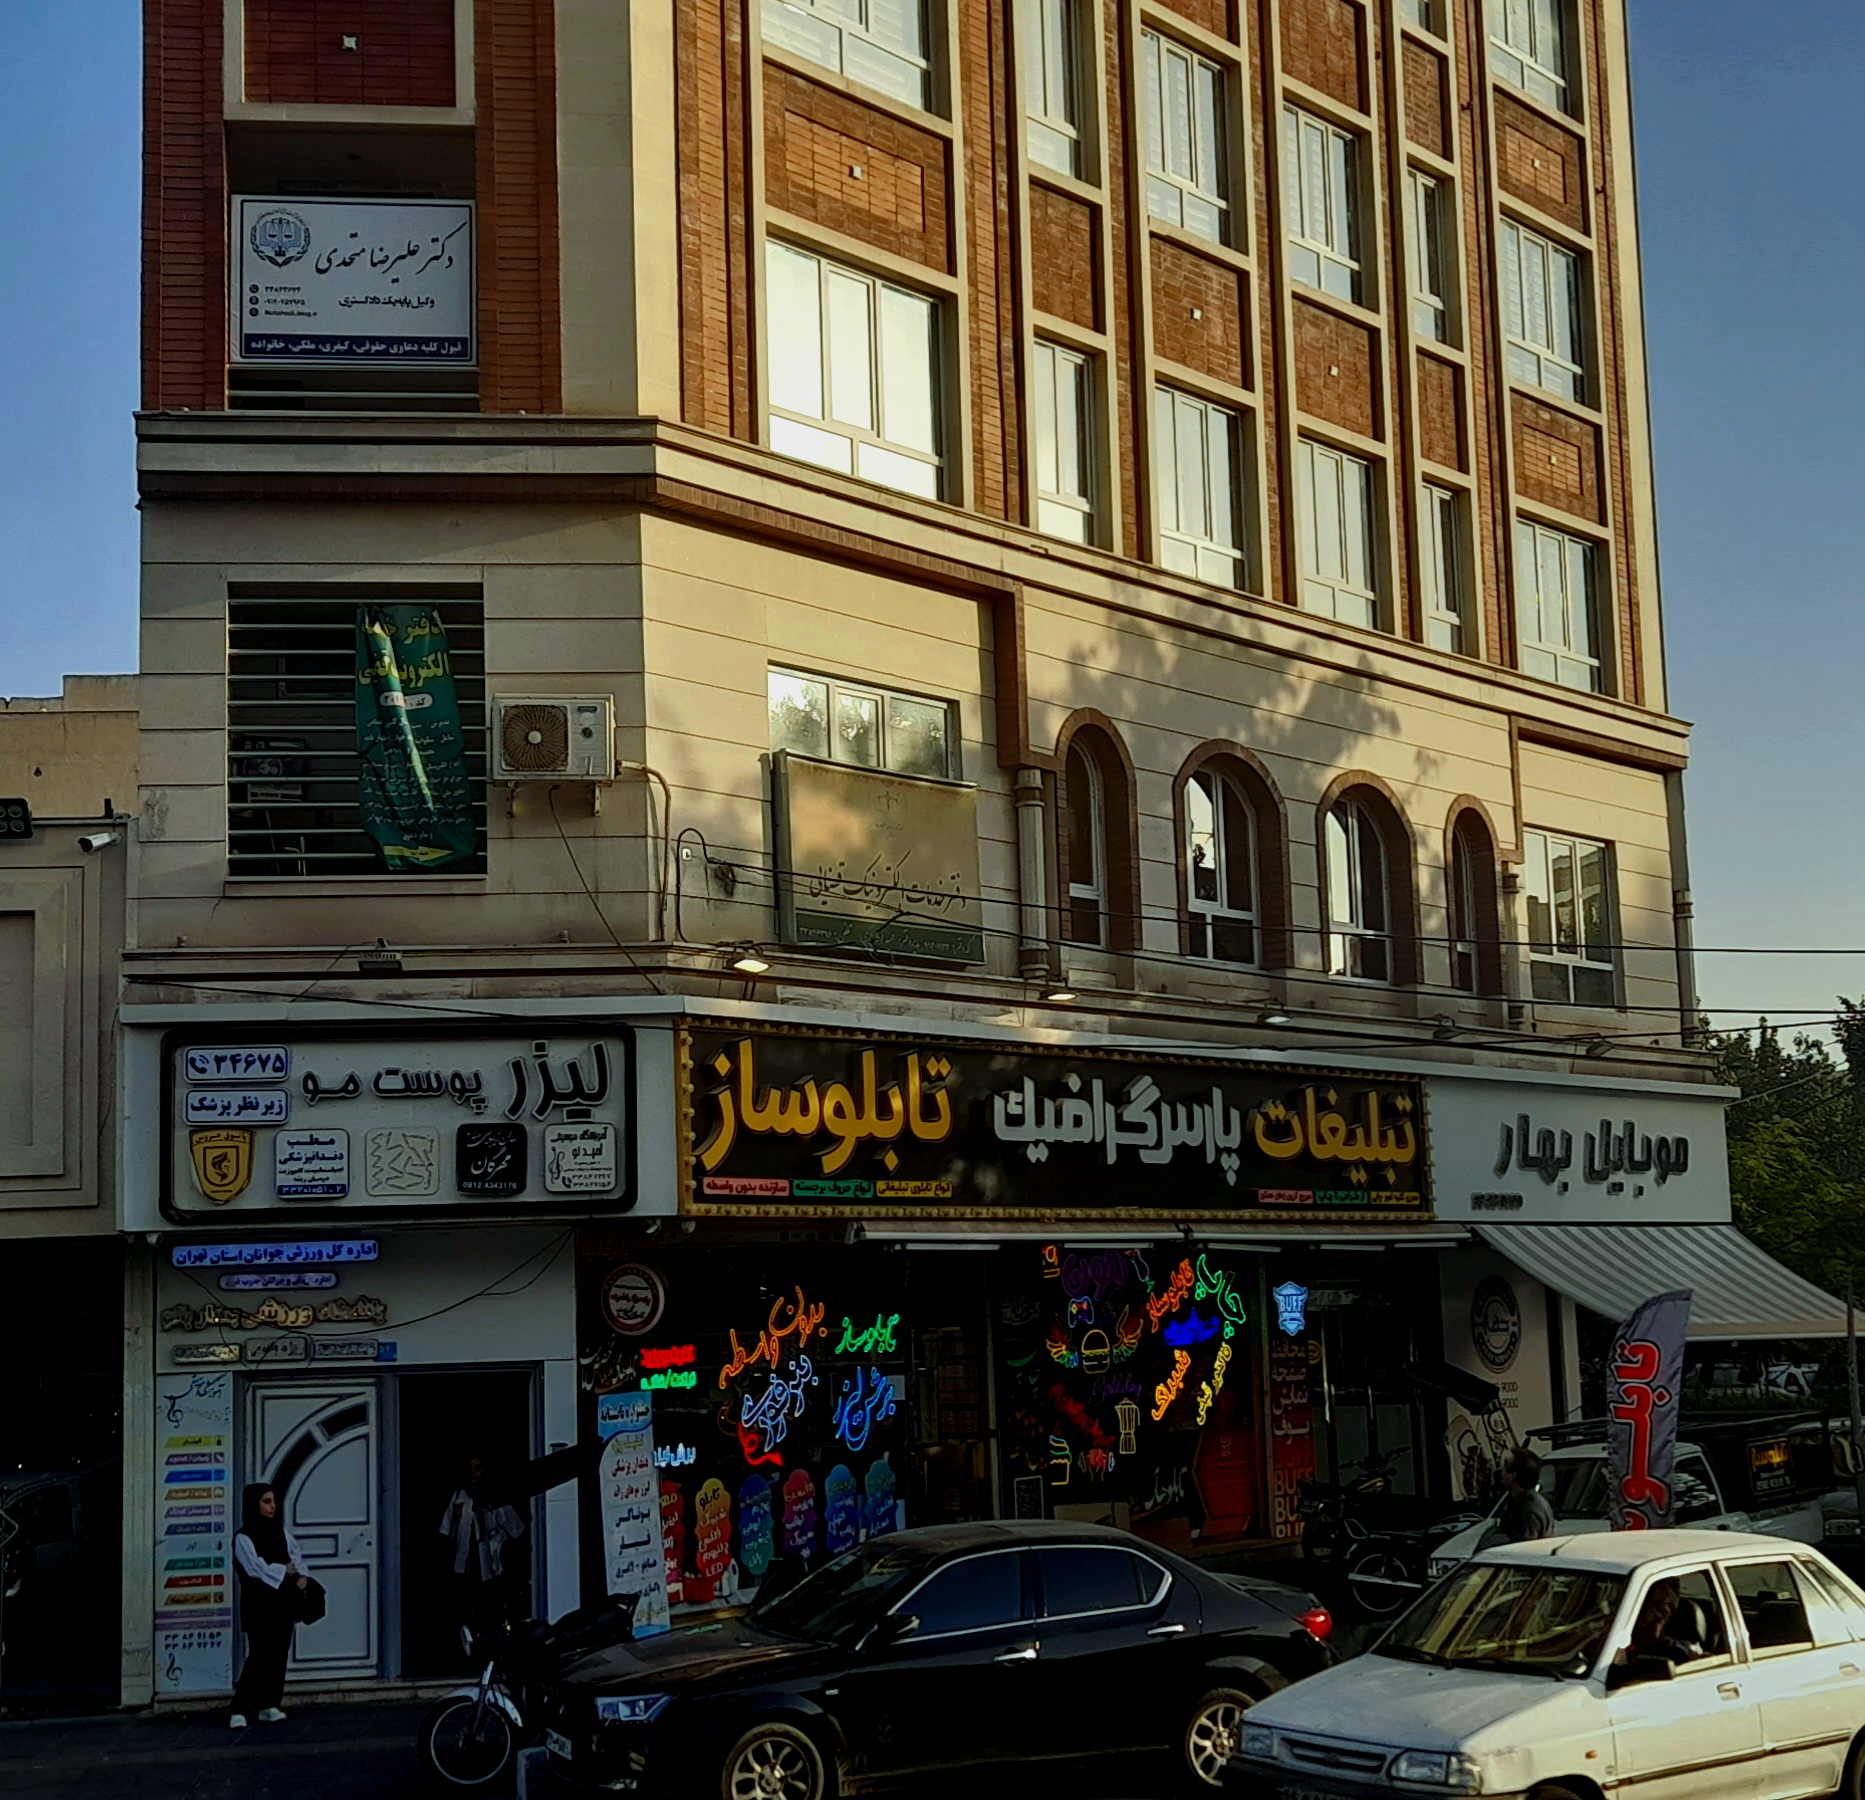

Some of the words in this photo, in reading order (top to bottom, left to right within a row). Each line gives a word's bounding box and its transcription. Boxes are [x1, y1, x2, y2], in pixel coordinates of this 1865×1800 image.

[314, 231, 367, 275] متحدی
[415, 220, 468, 275] دکتر
[369, 239, 420, 284] علیرضا
[412, 297, 435, 309] وکیل
[250, 338, 286, 352] خانواده
[388, 341, 419, 354] دعاوی
[421, 341, 439, 352] کلیه
[213, 1053, 285, 1075] ۳۴۶۷۵
[301, 1070, 363, 1107] مو
[372, 1067, 490, 1114] پوست
[504, 1040, 611, 1124] لیزر
[190, 1096, 232, 1117] پزشک
[234, 1095, 260, 1117] نظر
[261, 1098, 284, 1117] زیر
[692, 1035, 952, 1175] تابلوساز
[286, 1133, 336, 1149] مطب
[1250, 1084, 1417, 1185] تبلیغات
[1493, 1112, 1573, 1196] بهار
[1583, 1118, 1689, 1199] موبایل
[706, 1182, 735, 1194] واسطه
[735, 1183, 757, 1194] بدون
[795, 1183, 827, 1195] برجسته
[176, 1247, 208, 1265] تهران
[210, 1249, 243, 1264] استان
[243, 1246, 284, 1264] جوانان
[286, 1244, 324, 1262] ورزش
[326, 1243, 344, 1259] کل
[347, 1242, 378, 1260] اداره
[241, 1296, 315, 1329] ورزشی
[768, 1285, 828, 1348] بدون
[835, 1313, 900, 1355] تابلوساز
[1271, 1340, 1306, 1358] محافظ
[1271, 1362, 1307, 1382] صفحه
[1272, 1385, 1309, 1416] نمایش
[1273, 1413, 1310, 1445] بوف
[700, 1487, 720, 1511] تابلو
[706, 1563, 724, 1578] LED
